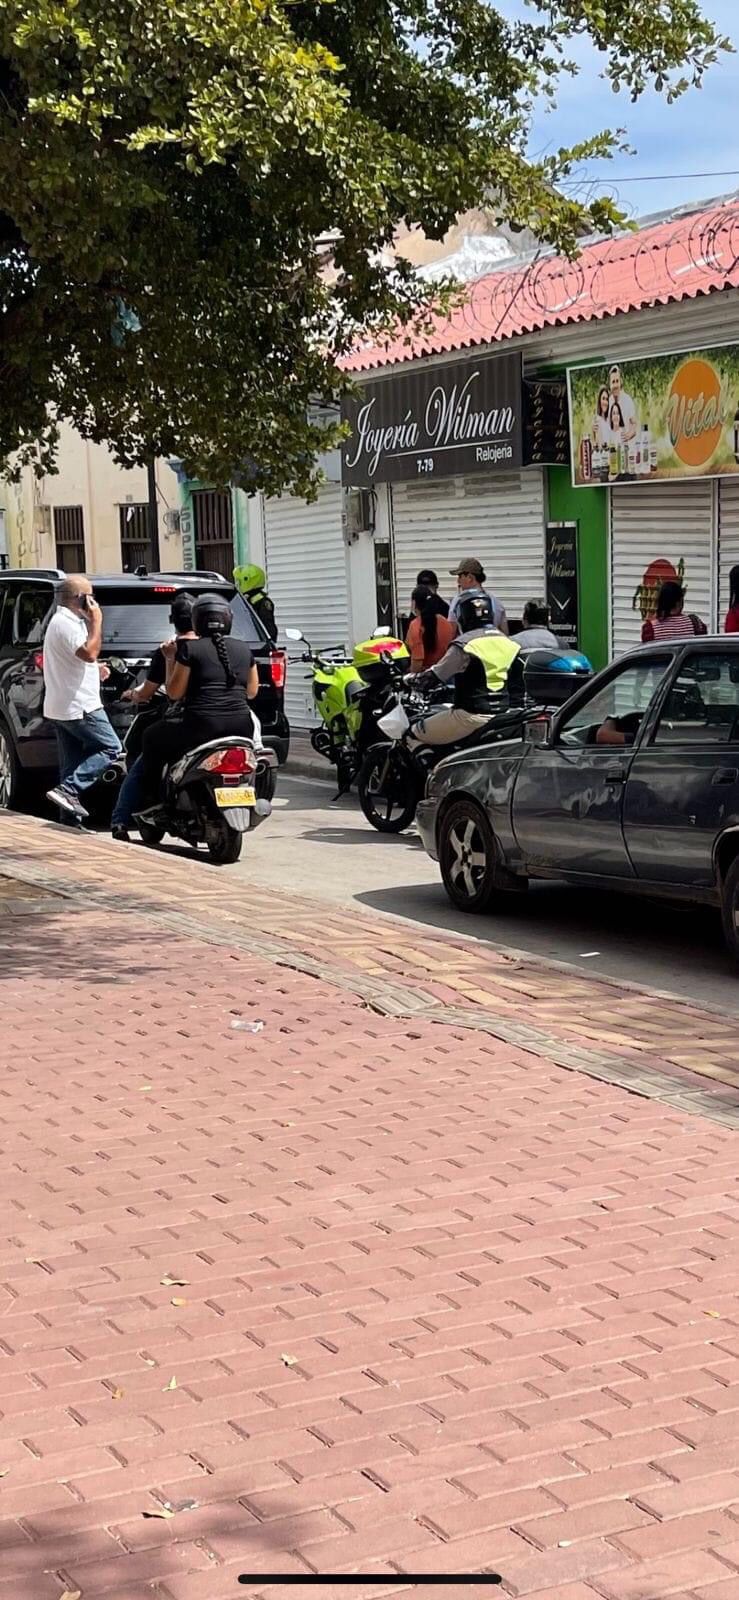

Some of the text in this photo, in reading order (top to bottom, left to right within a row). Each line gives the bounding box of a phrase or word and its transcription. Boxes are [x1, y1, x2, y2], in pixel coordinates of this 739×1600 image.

[345, 371, 515, 477] Joyería Wilman
[416, 459, 434, 473] 7-79
